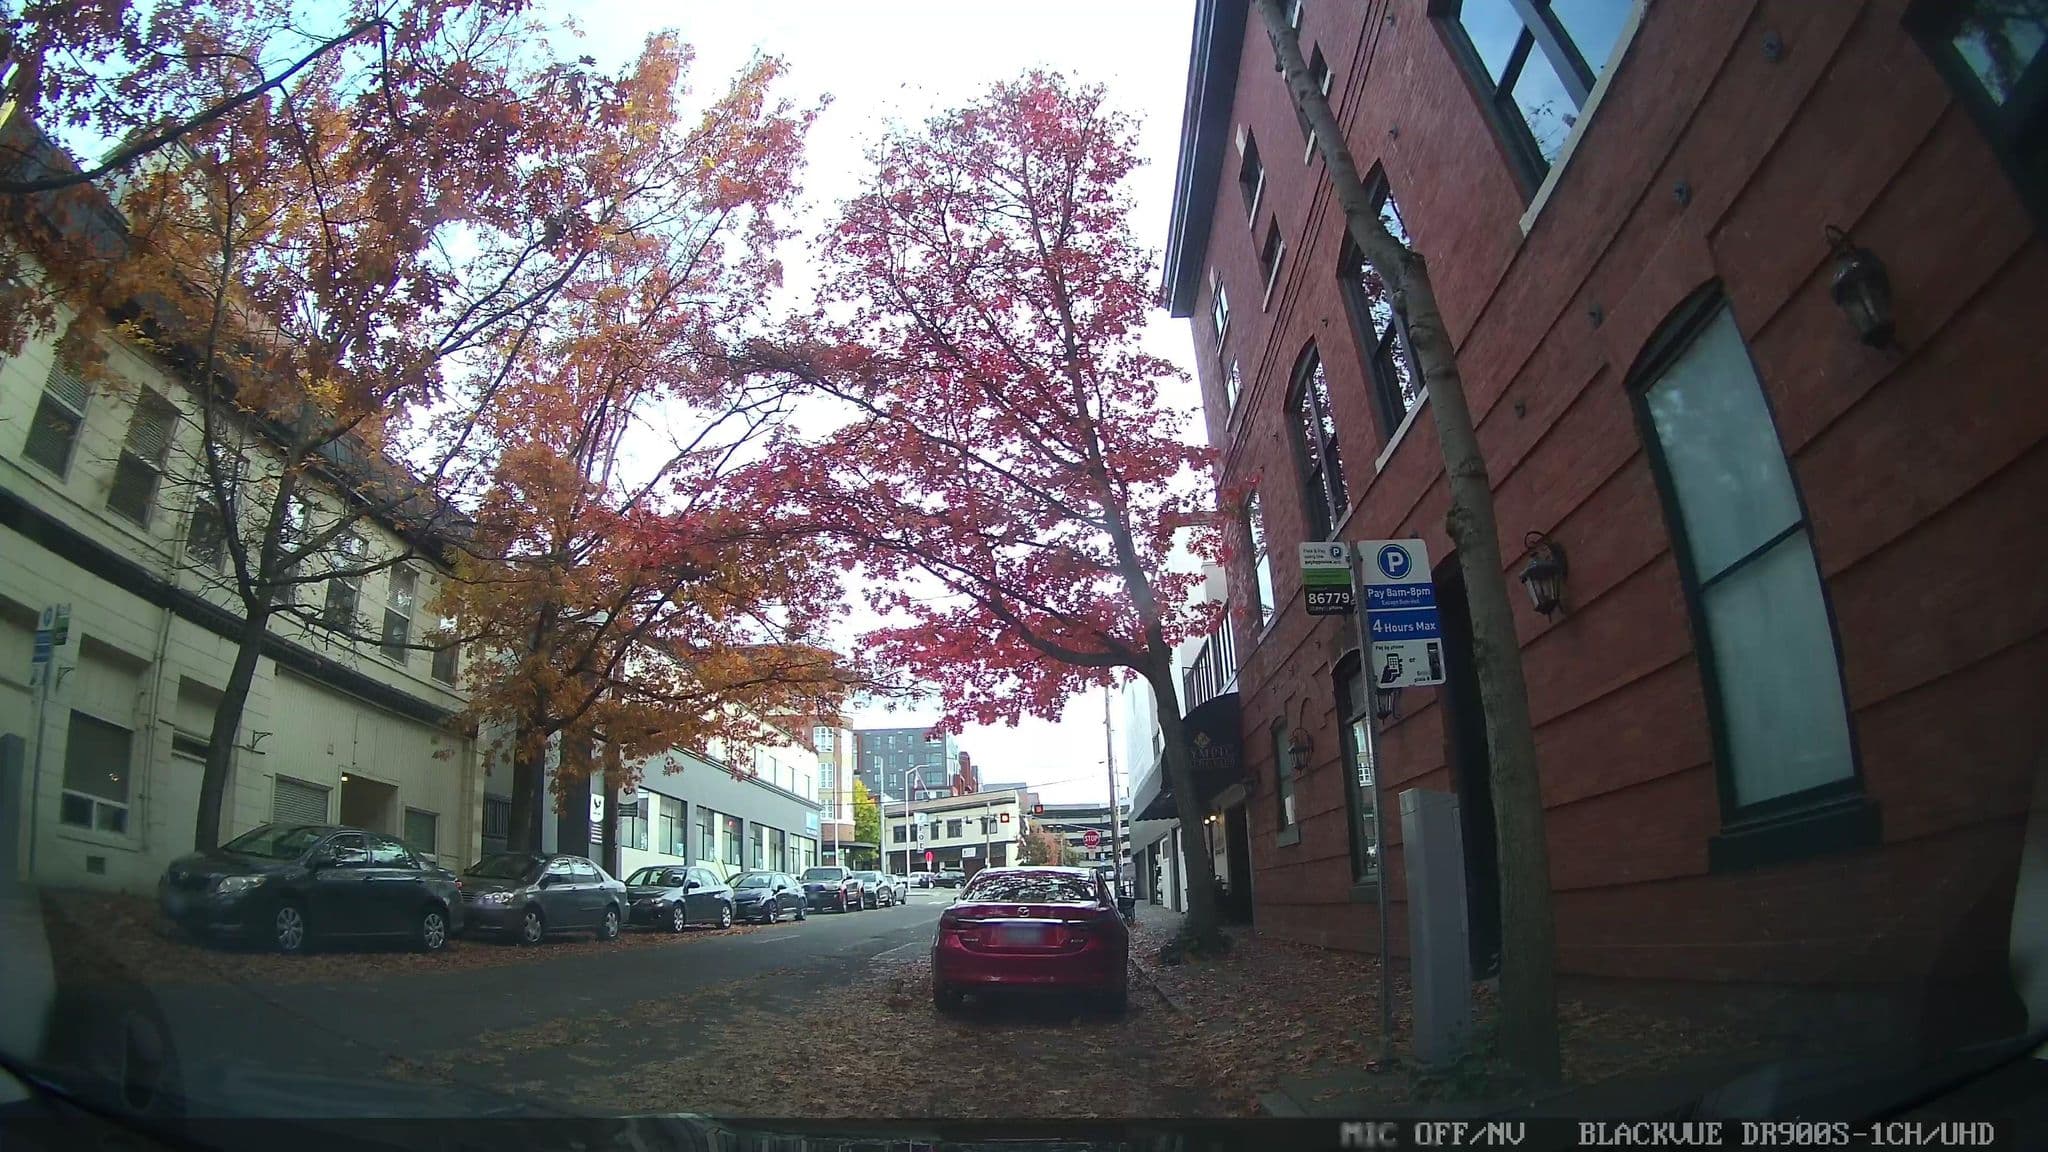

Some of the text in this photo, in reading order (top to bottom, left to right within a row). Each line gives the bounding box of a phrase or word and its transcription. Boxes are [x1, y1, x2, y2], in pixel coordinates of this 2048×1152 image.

[1387, 552, 1404, 572] P
[1308, 592, 1350, 604] 86779
[1367, 587, 1431, 599] Pay 8am-8pm
[1372, 619, 1437, 633] 4 Hours Max
